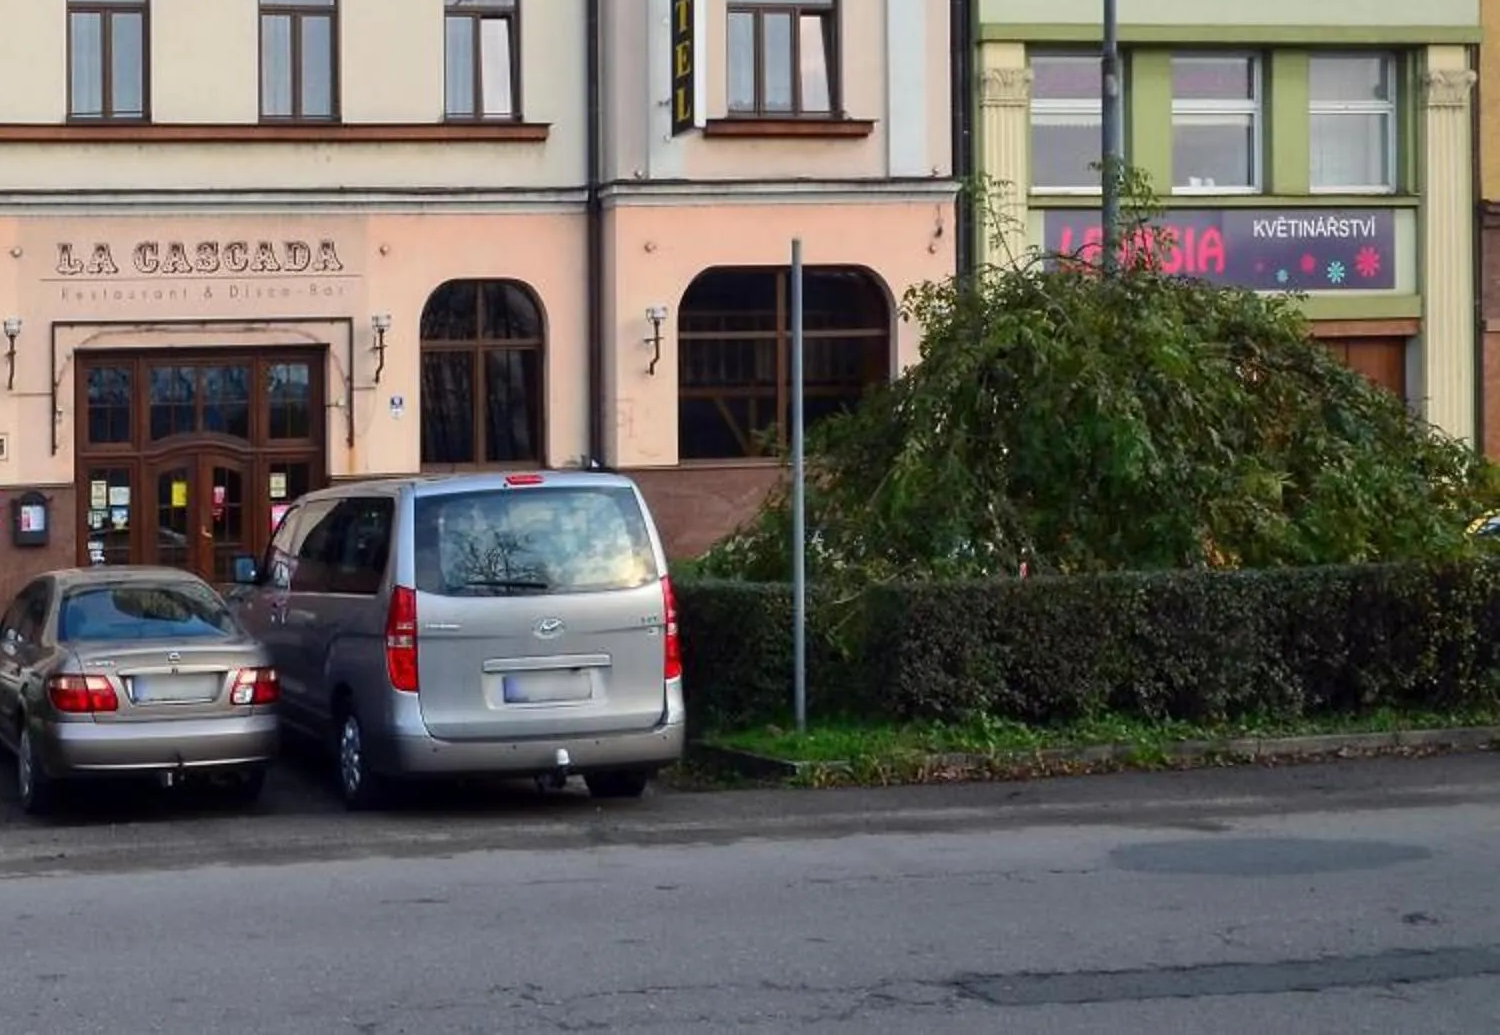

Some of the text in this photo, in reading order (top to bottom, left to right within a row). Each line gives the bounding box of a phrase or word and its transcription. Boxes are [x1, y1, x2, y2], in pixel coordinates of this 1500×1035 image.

[1253, 215, 1376, 238] KVĚTINÁŘSTVÍ
[56, 241, 344, 274] LA CASCADA
[61, 288, 188, 300] Restaurant
[204, 287, 213, 299] &
